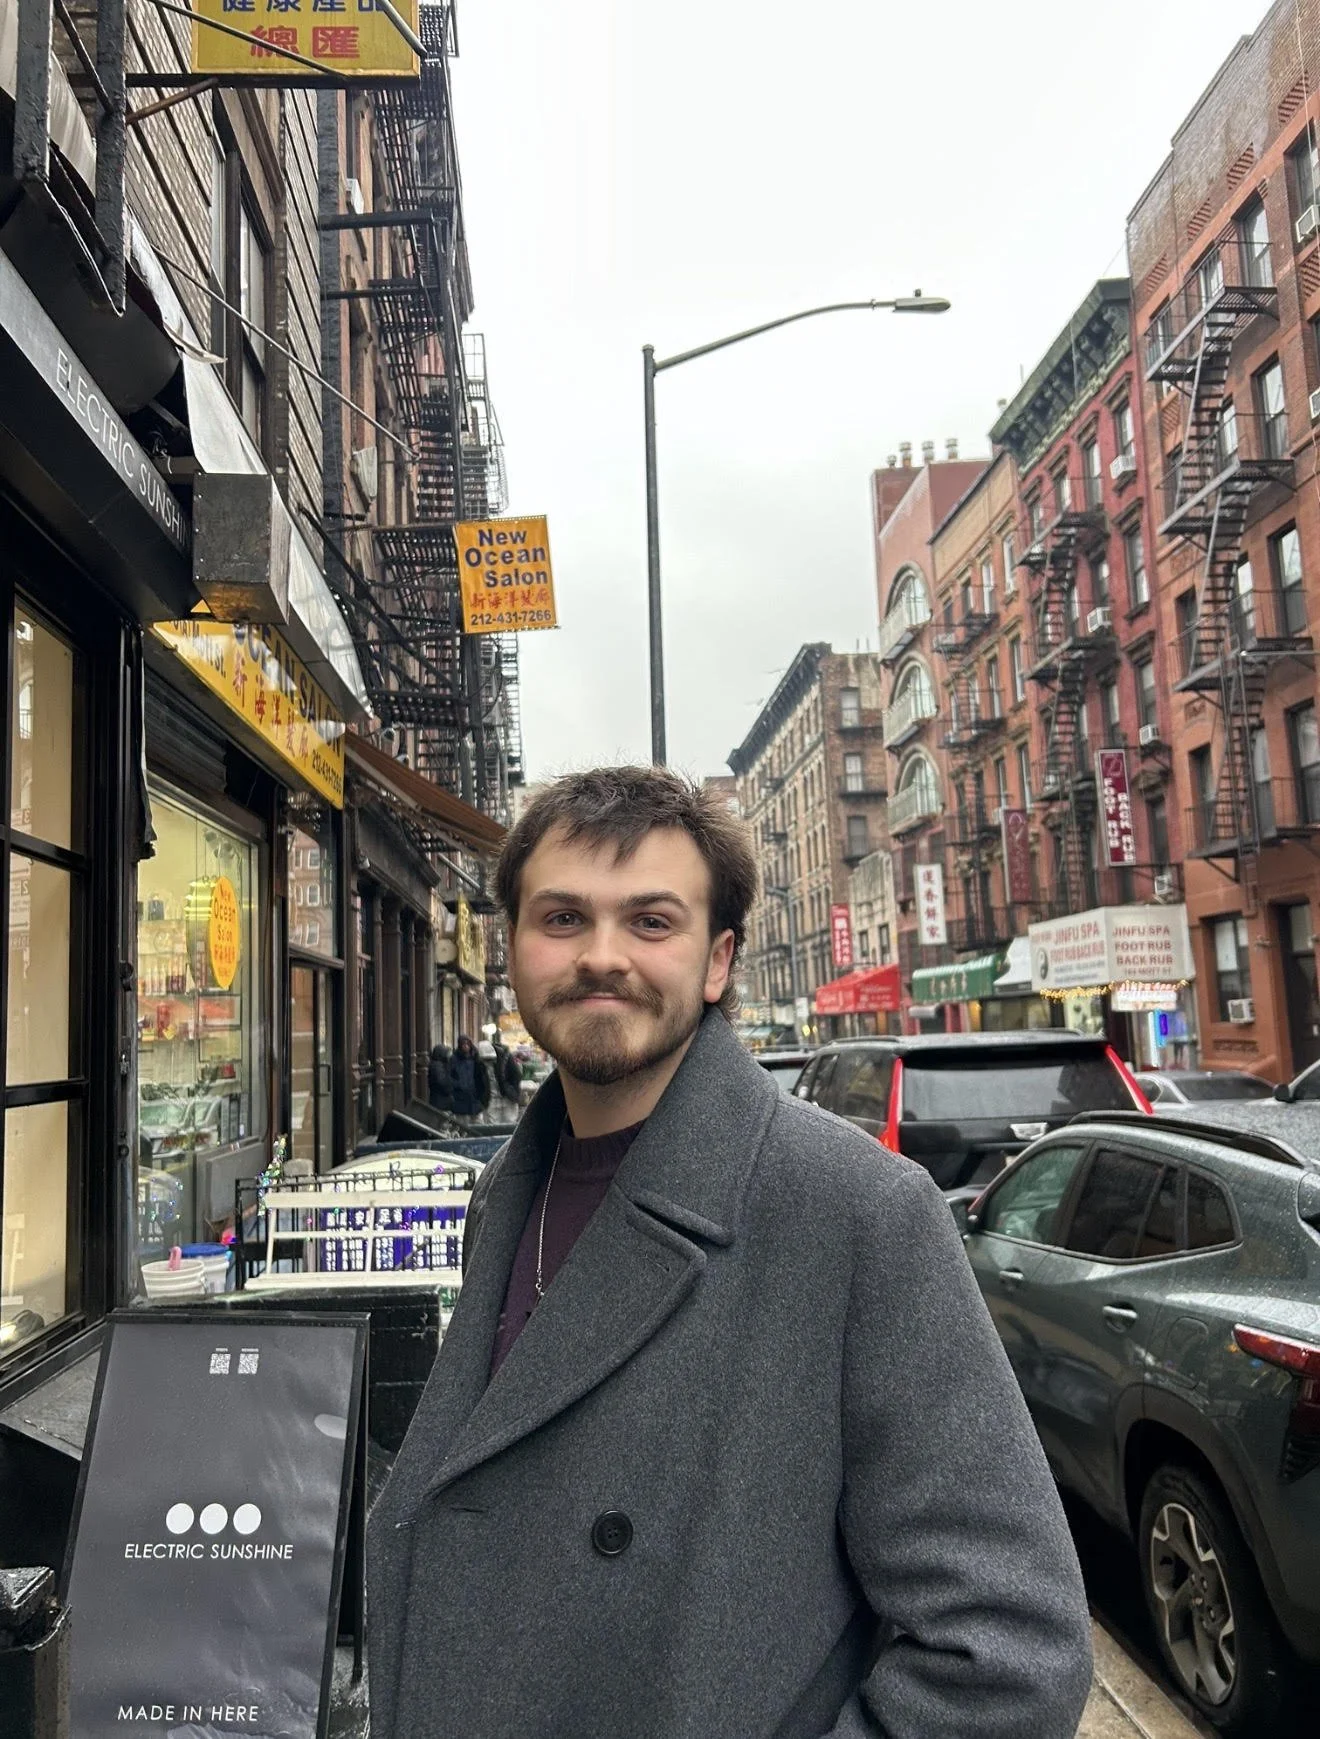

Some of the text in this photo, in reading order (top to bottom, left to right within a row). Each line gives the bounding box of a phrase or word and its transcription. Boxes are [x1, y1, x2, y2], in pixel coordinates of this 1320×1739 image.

[57, 348, 135, 478] ELECTRIC
[478, 528, 527, 546] New
[465, 546, 546, 567] Ocean
[485, 568, 548, 588] Salon
[471, 609, 552, 625] 212-431-7266
[1103, 777, 1116, 815] FOOT
[1080, 921, 1100, 939] SPA
[1112, 925, 1170, 936] JINFU SPA
[1114, 940, 1172, 951] FOOT RUB
[1116, 954, 1173, 965] BACK RUB
[125, 1543, 294, 1559] ELECTRIC SUNSHINE
[117, 1705, 259, 1721] MADE IN HERE
